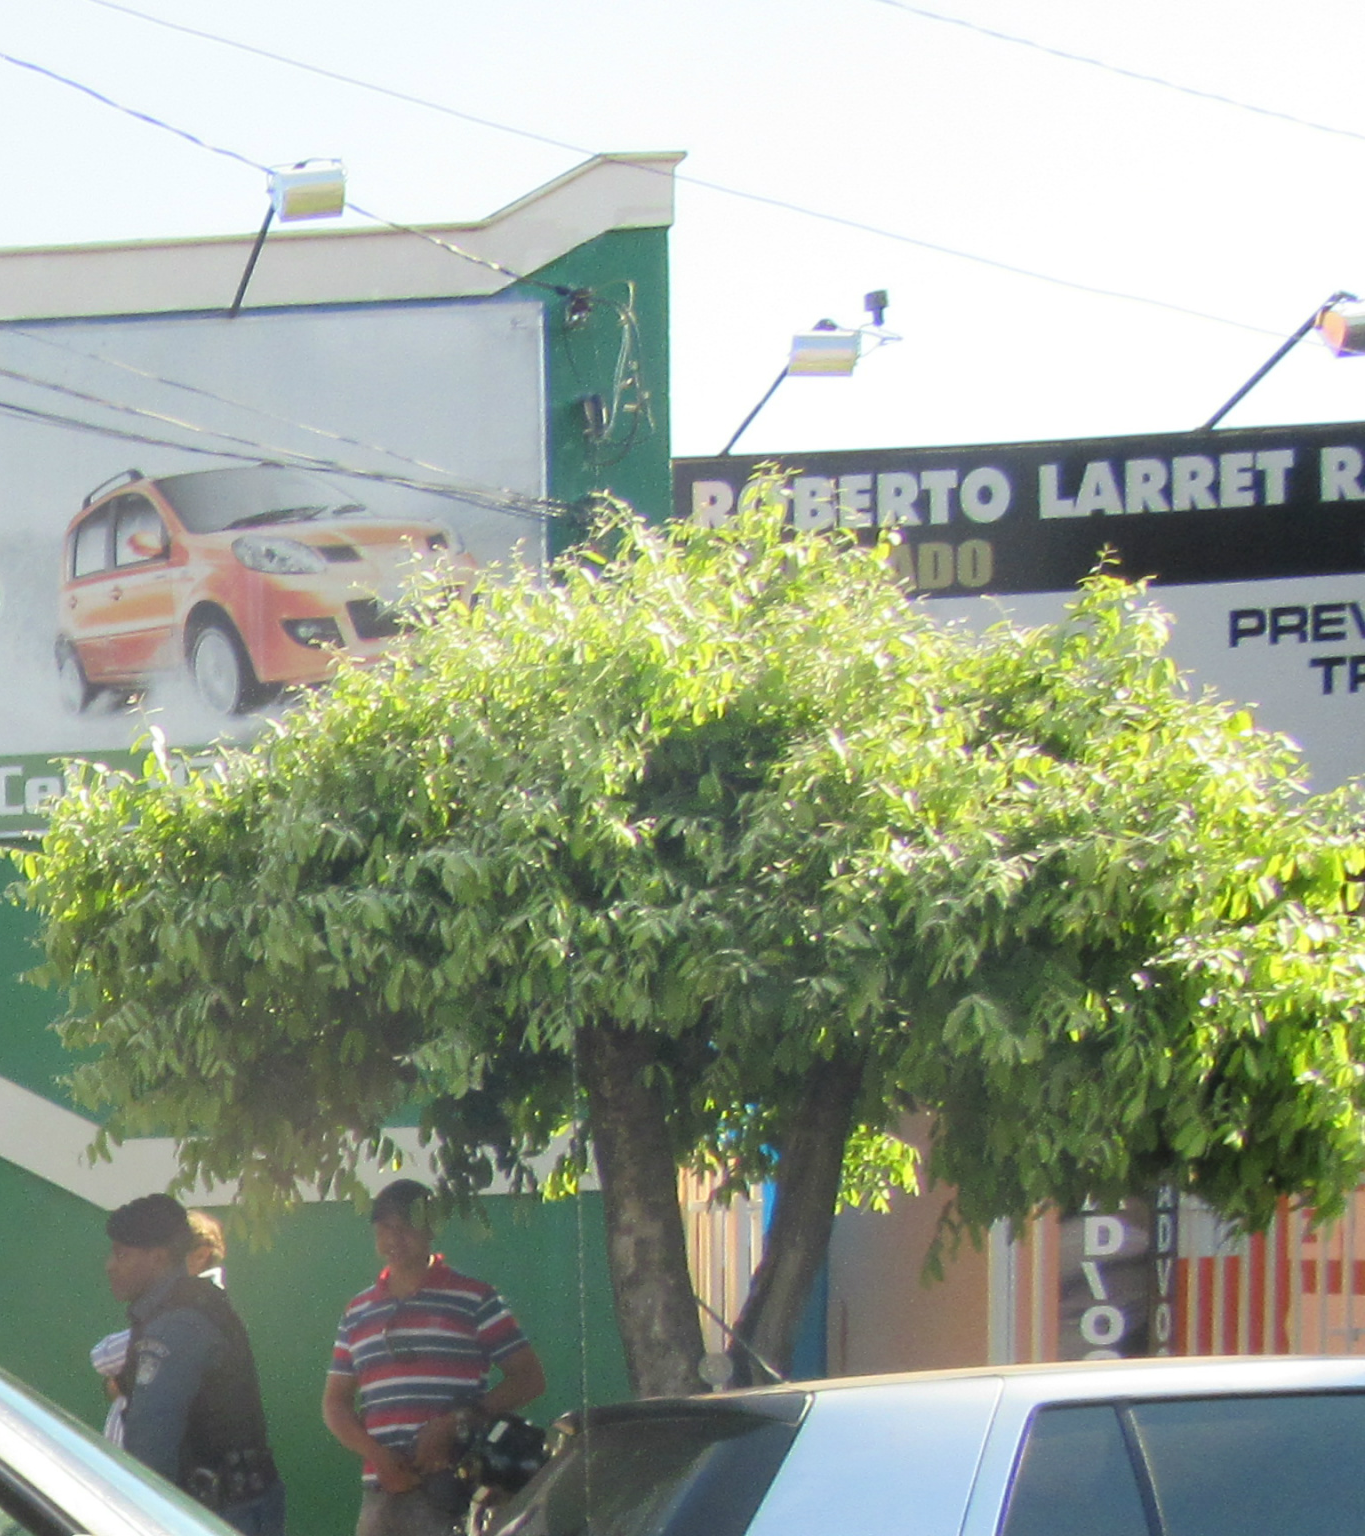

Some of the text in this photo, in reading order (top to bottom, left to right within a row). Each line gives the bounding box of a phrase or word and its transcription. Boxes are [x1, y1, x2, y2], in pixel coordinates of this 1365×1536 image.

[691, 466, 1011, 530] ROBERTO
[1038, 449, 1295, 519] LARRET
[1155, 1185, 1174, 1357] ADVO
